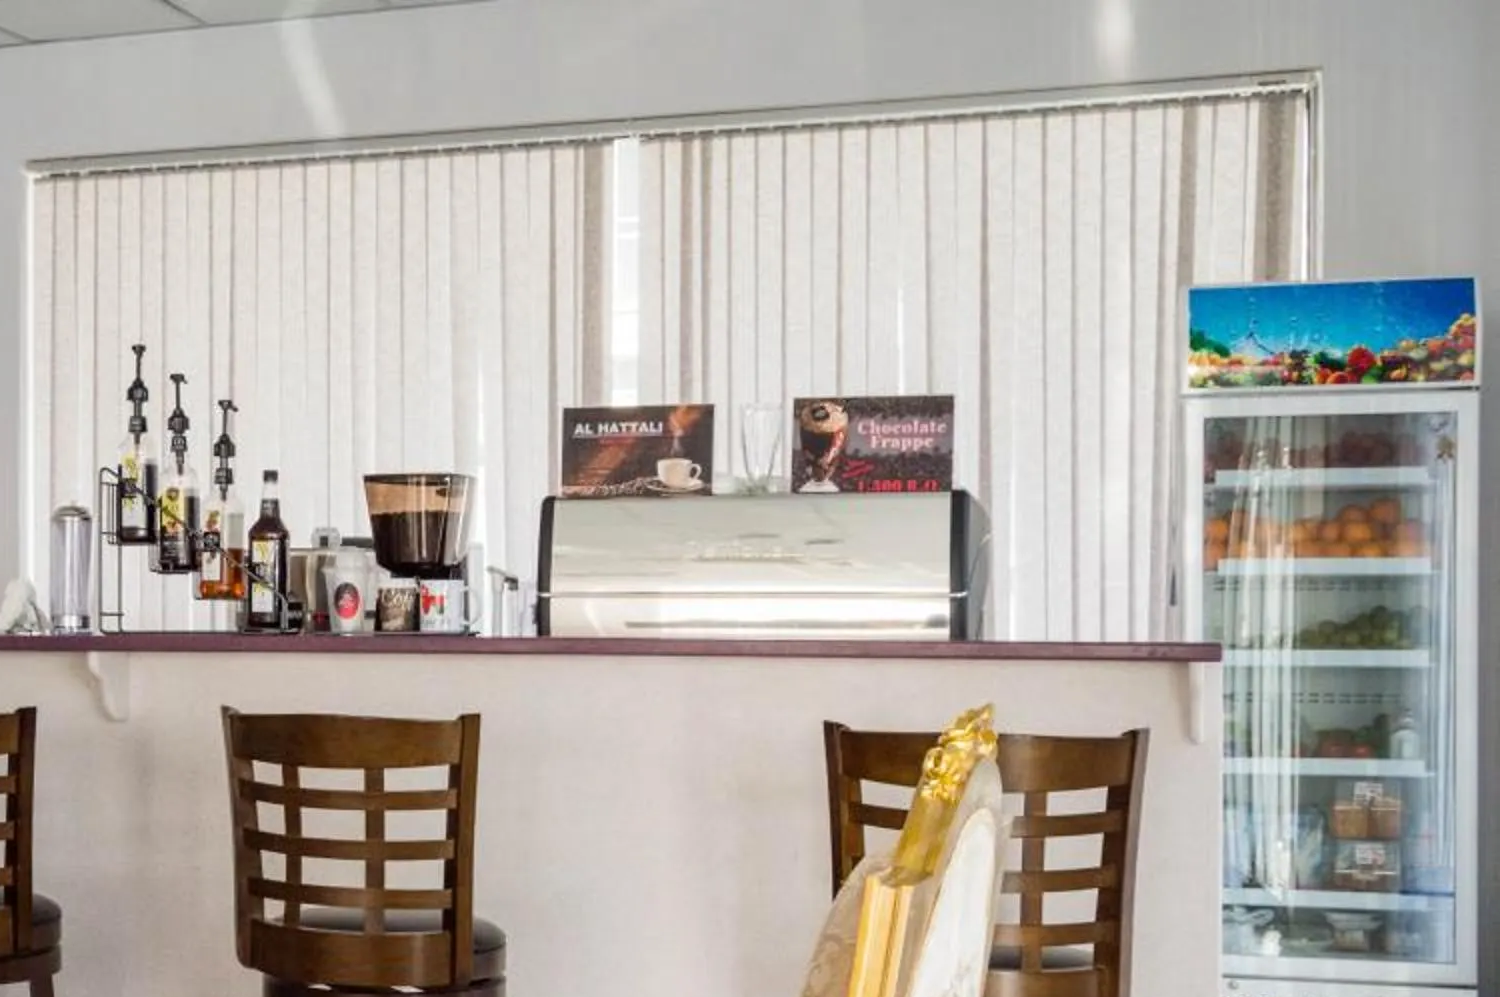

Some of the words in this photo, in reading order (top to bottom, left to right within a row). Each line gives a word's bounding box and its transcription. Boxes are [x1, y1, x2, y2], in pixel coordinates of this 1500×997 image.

[573, 422, 594, 435] AL
[597, 420, 664, 434] HATTALI
[857, 419, 948, 435] Chocolate
[870, 435, 935, 452] Frappe
